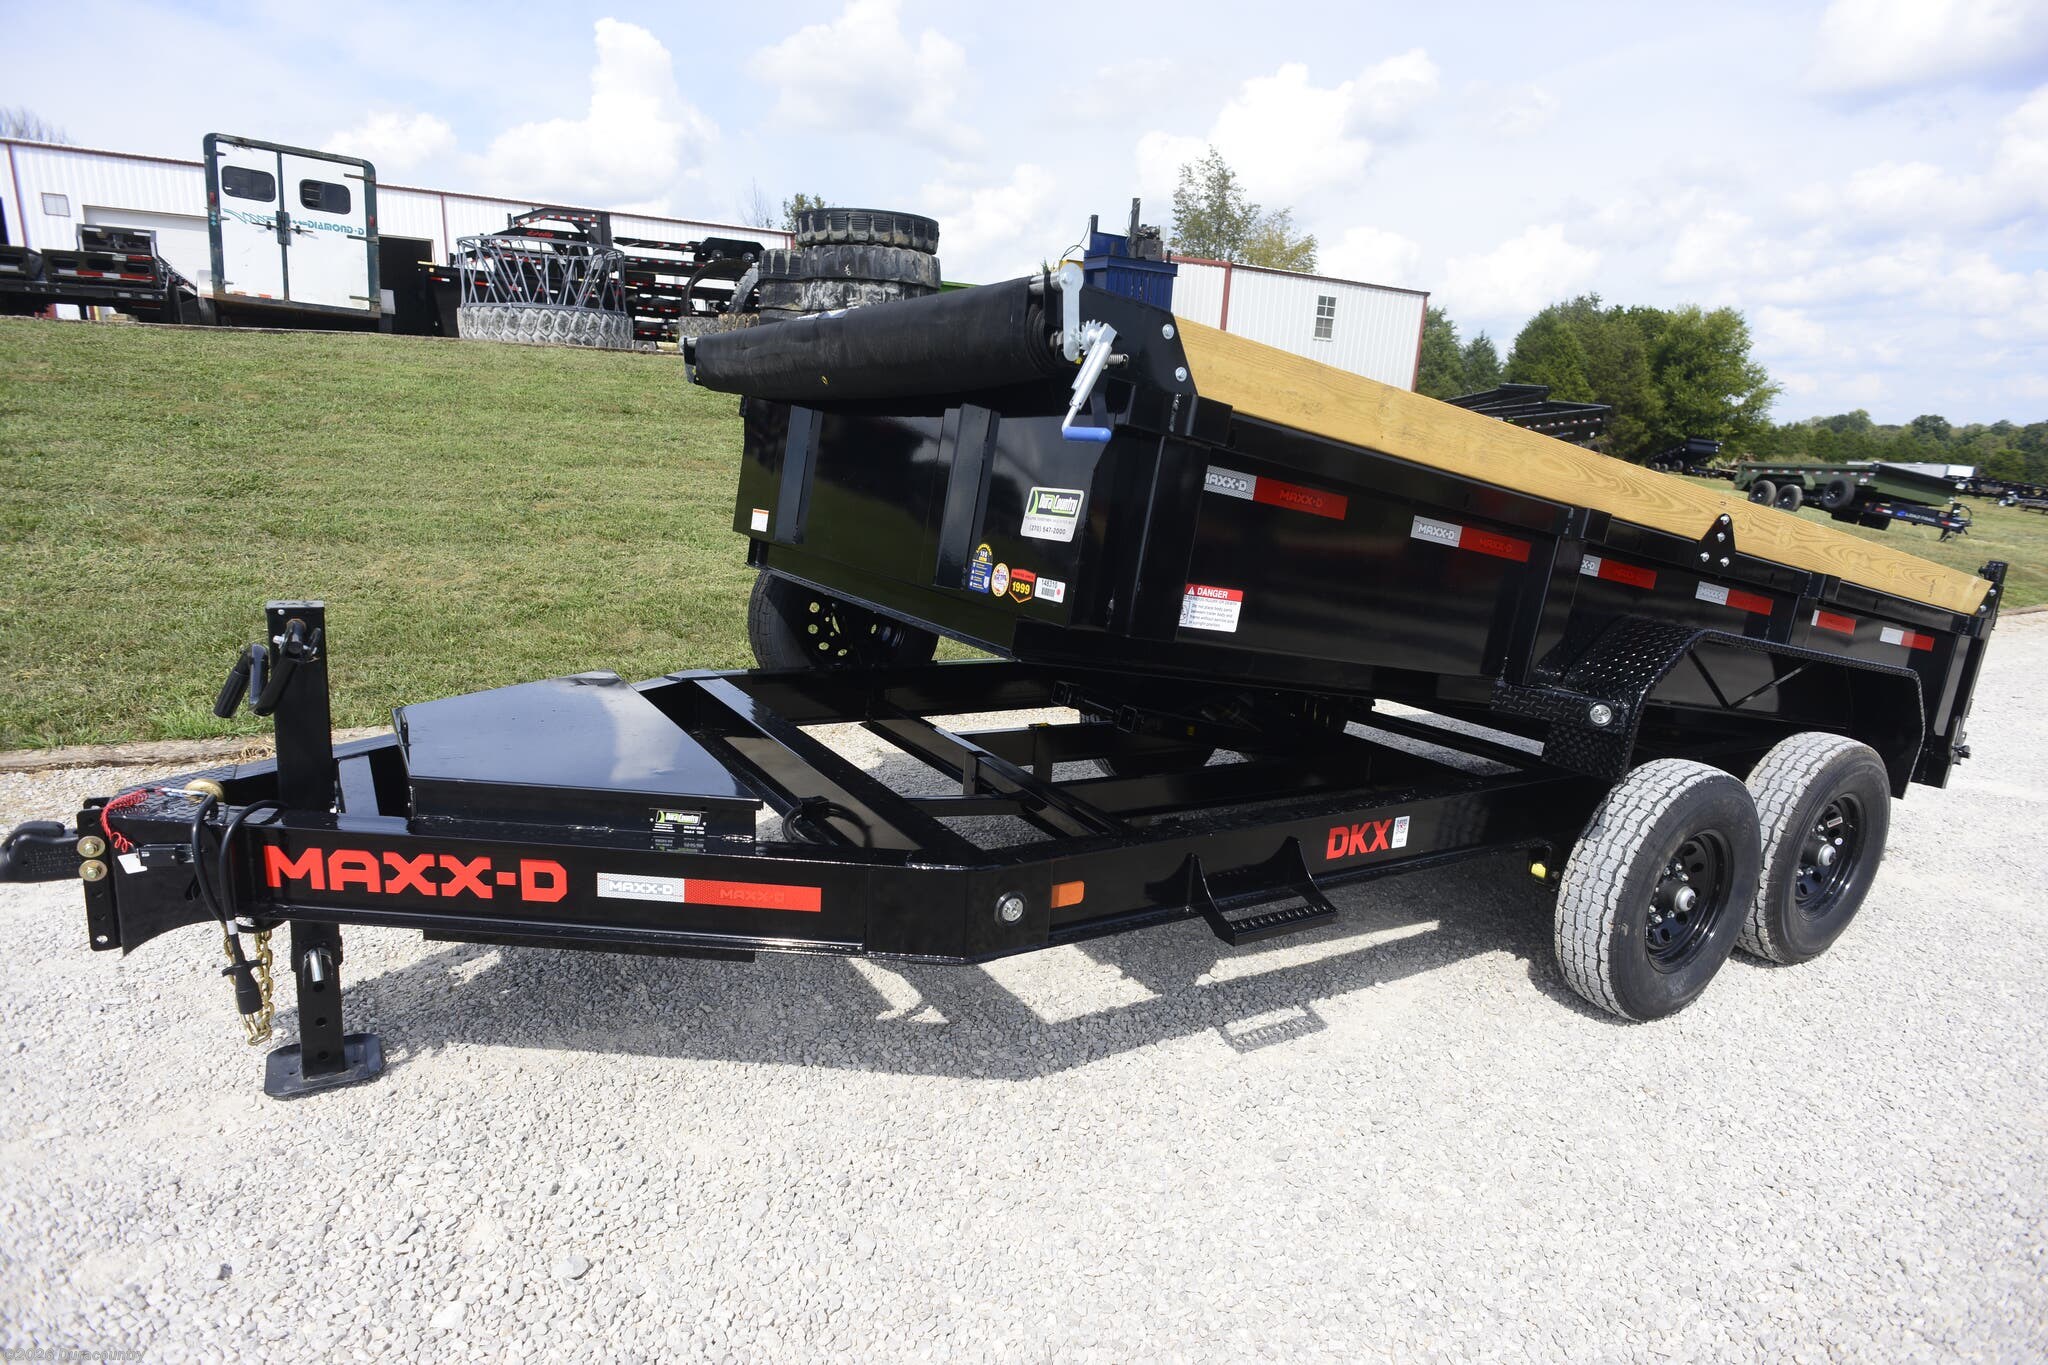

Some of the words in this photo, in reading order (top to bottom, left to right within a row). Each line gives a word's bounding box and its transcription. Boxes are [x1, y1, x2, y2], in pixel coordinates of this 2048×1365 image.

[1012, 581, 1031, 595] 1999
[1197, 587, 1229, 599] DANGER
[1326, 818, 1393, 860] DKX
[264, 845, 567, 902] MAXX-D
[608, 880, 673, 896] MAXX-D
[719, 888, 785, 903] MAXX-D
